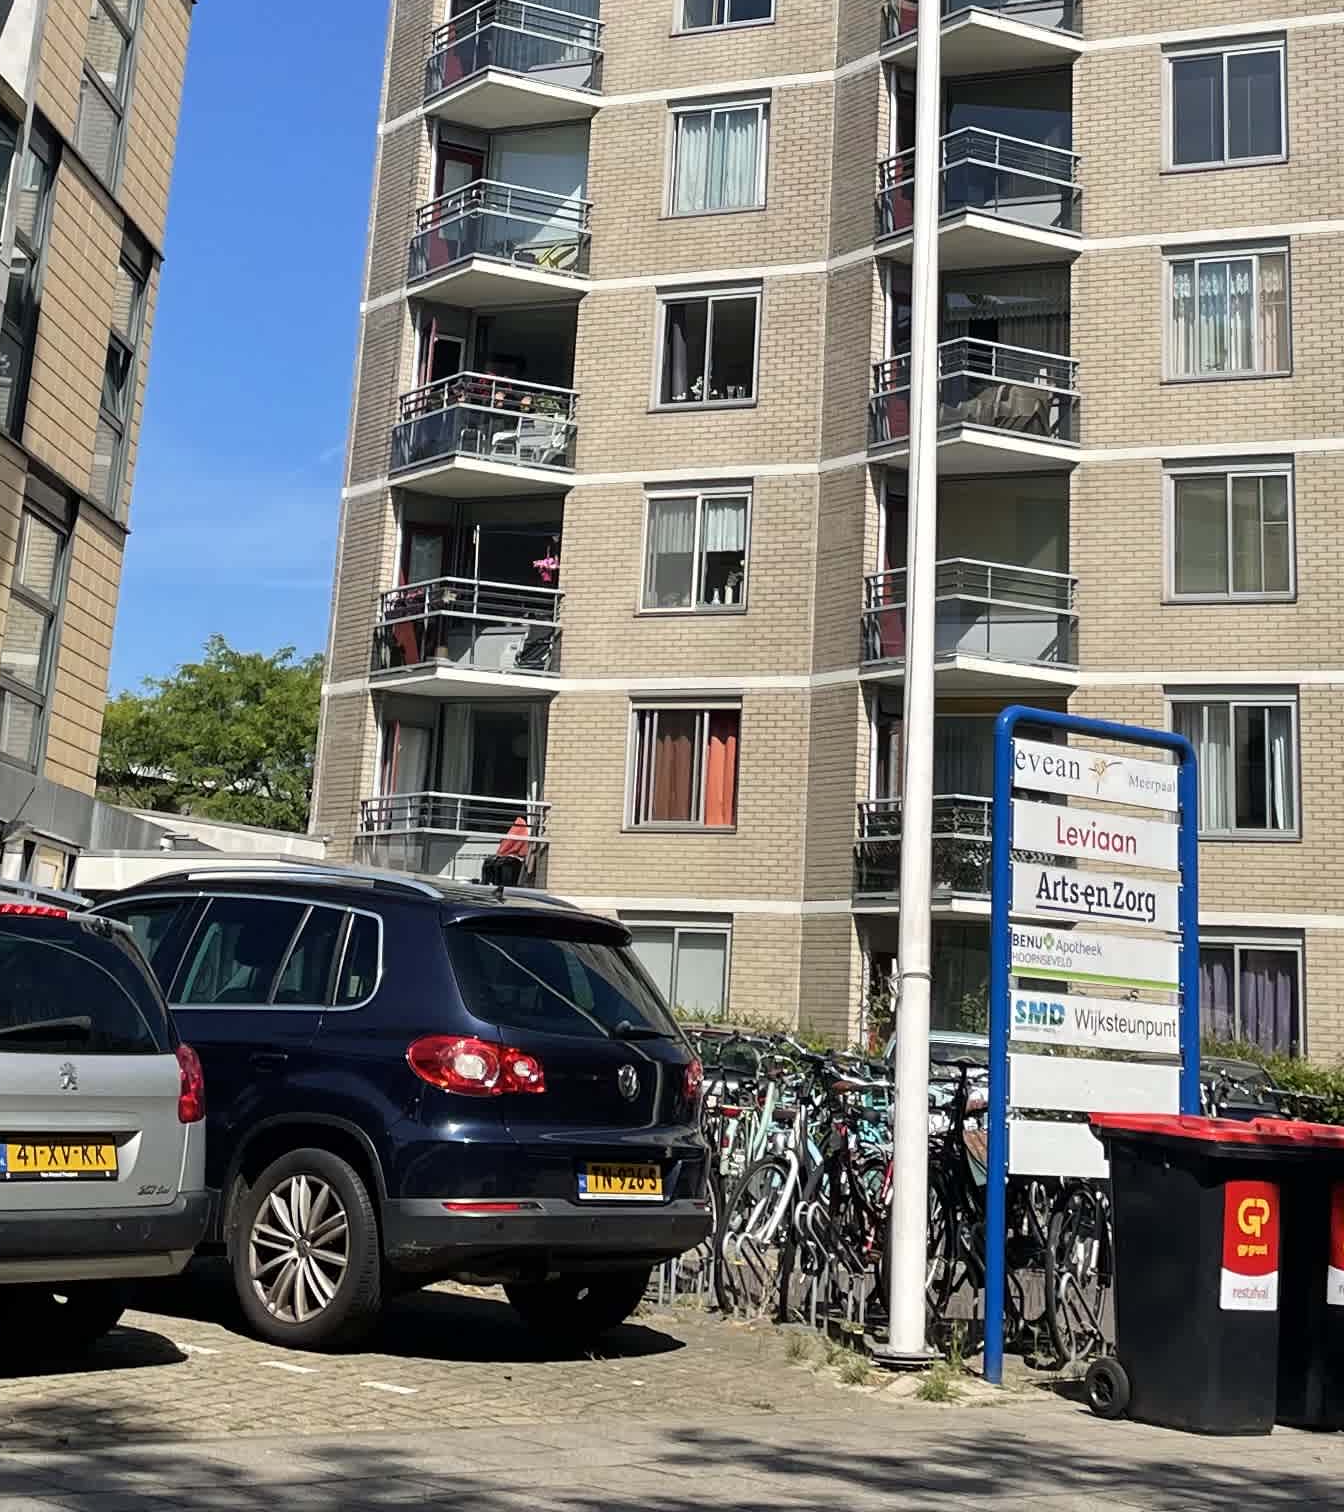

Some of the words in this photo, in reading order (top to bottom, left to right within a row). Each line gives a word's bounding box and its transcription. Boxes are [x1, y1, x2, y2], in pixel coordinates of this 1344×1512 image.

[1015, 750, 1081, 780] evean
[1128, 774, 1176, 794] Meerpaal
[1057, 816, 1137, 855] Leviaan
[1012, 933, 1043, 951] BENU
[1056, 939, 1103, 957] Apotheek
[1014, 999, 1067, 1026] SMD
[1074, 1006, 1177, 1040] Wijksteunpunt
